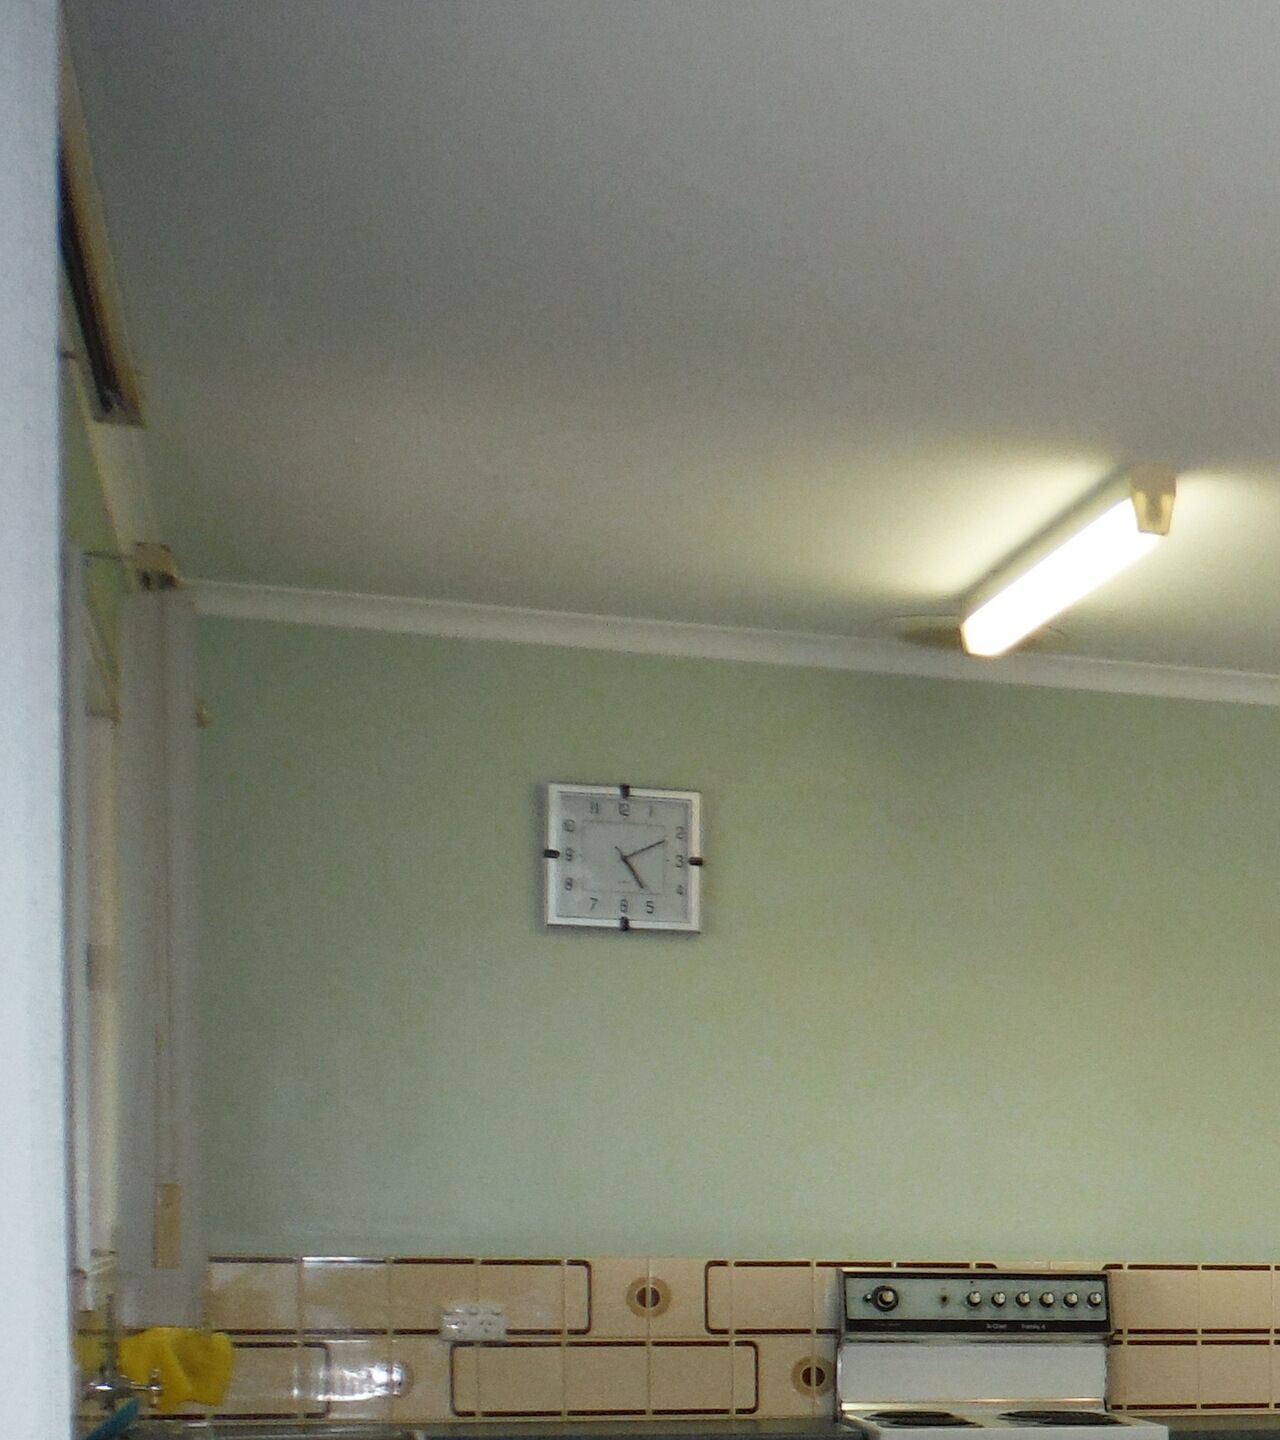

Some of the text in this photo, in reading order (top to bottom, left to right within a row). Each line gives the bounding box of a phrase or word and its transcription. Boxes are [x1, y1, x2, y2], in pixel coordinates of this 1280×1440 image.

[675, 826, 685, 839] 2
[565, 847, 575, 861] 9
[675, 854, 684, 868] 3
[589, 897, 598, 911] 7
[646, 900, 655, 914] 5
